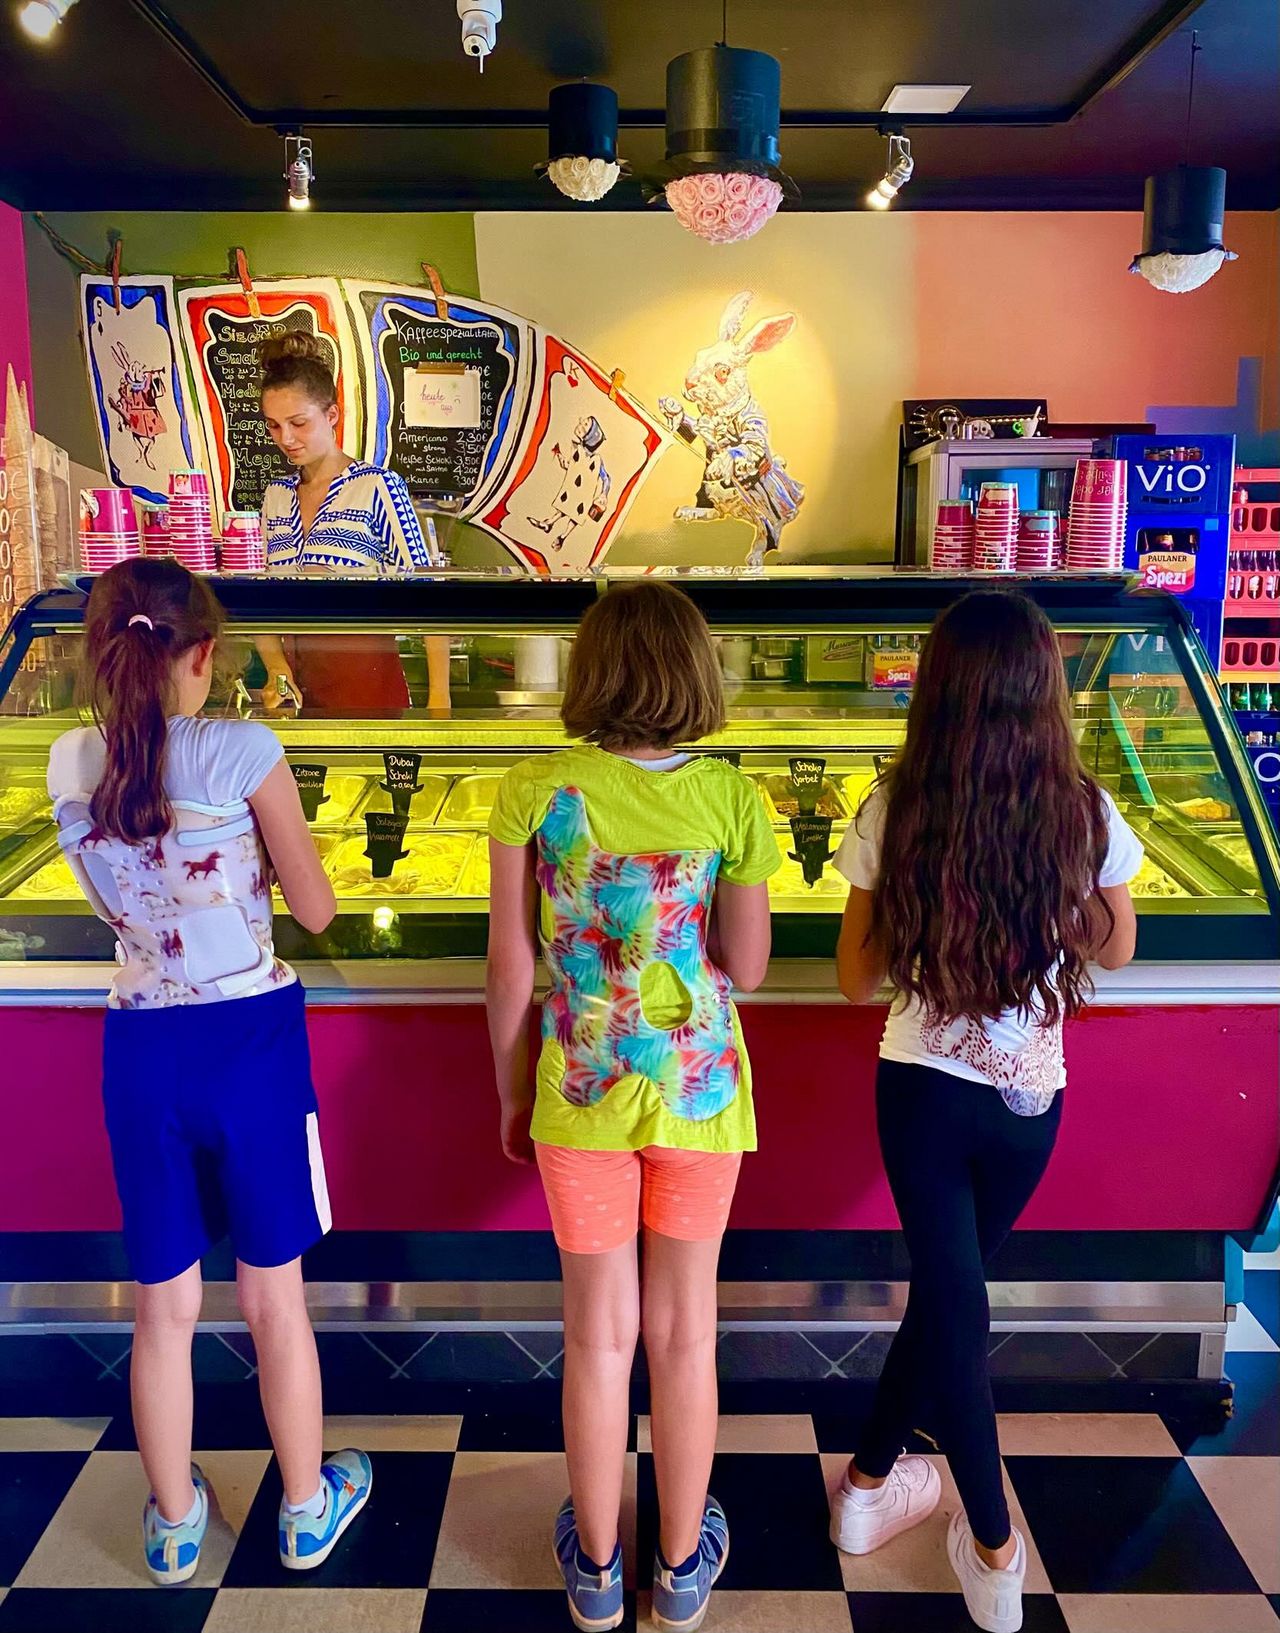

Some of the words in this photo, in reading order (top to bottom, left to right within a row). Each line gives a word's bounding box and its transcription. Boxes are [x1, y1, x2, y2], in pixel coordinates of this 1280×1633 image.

[213, 348, 259, 365] Smal
[399, 346, 420, 363] Bio
[426, 348, 443, 360] und
[446, 347, 482, 363] gerecht
[249, 367, 258, 378] 2
[251, 402, 260, 412] 3
[254, 436, 262, 447] 4
[422, 443, 446, 454] strong
[233, 448, 281, 469] Mega
[396, 453, 423, 465] Heiße
[1146, 564, 1187, 585] Spezi
[887, 668, 911, 683] Spezi
[388, 755, 414, 767] Dubai
[795, 760, 822, 773] Schoko
[295, 768, 320, 777] Zitrone
[388, 769, 413, 781] Schoki
[793, 773, 819, 787] Sorbet
